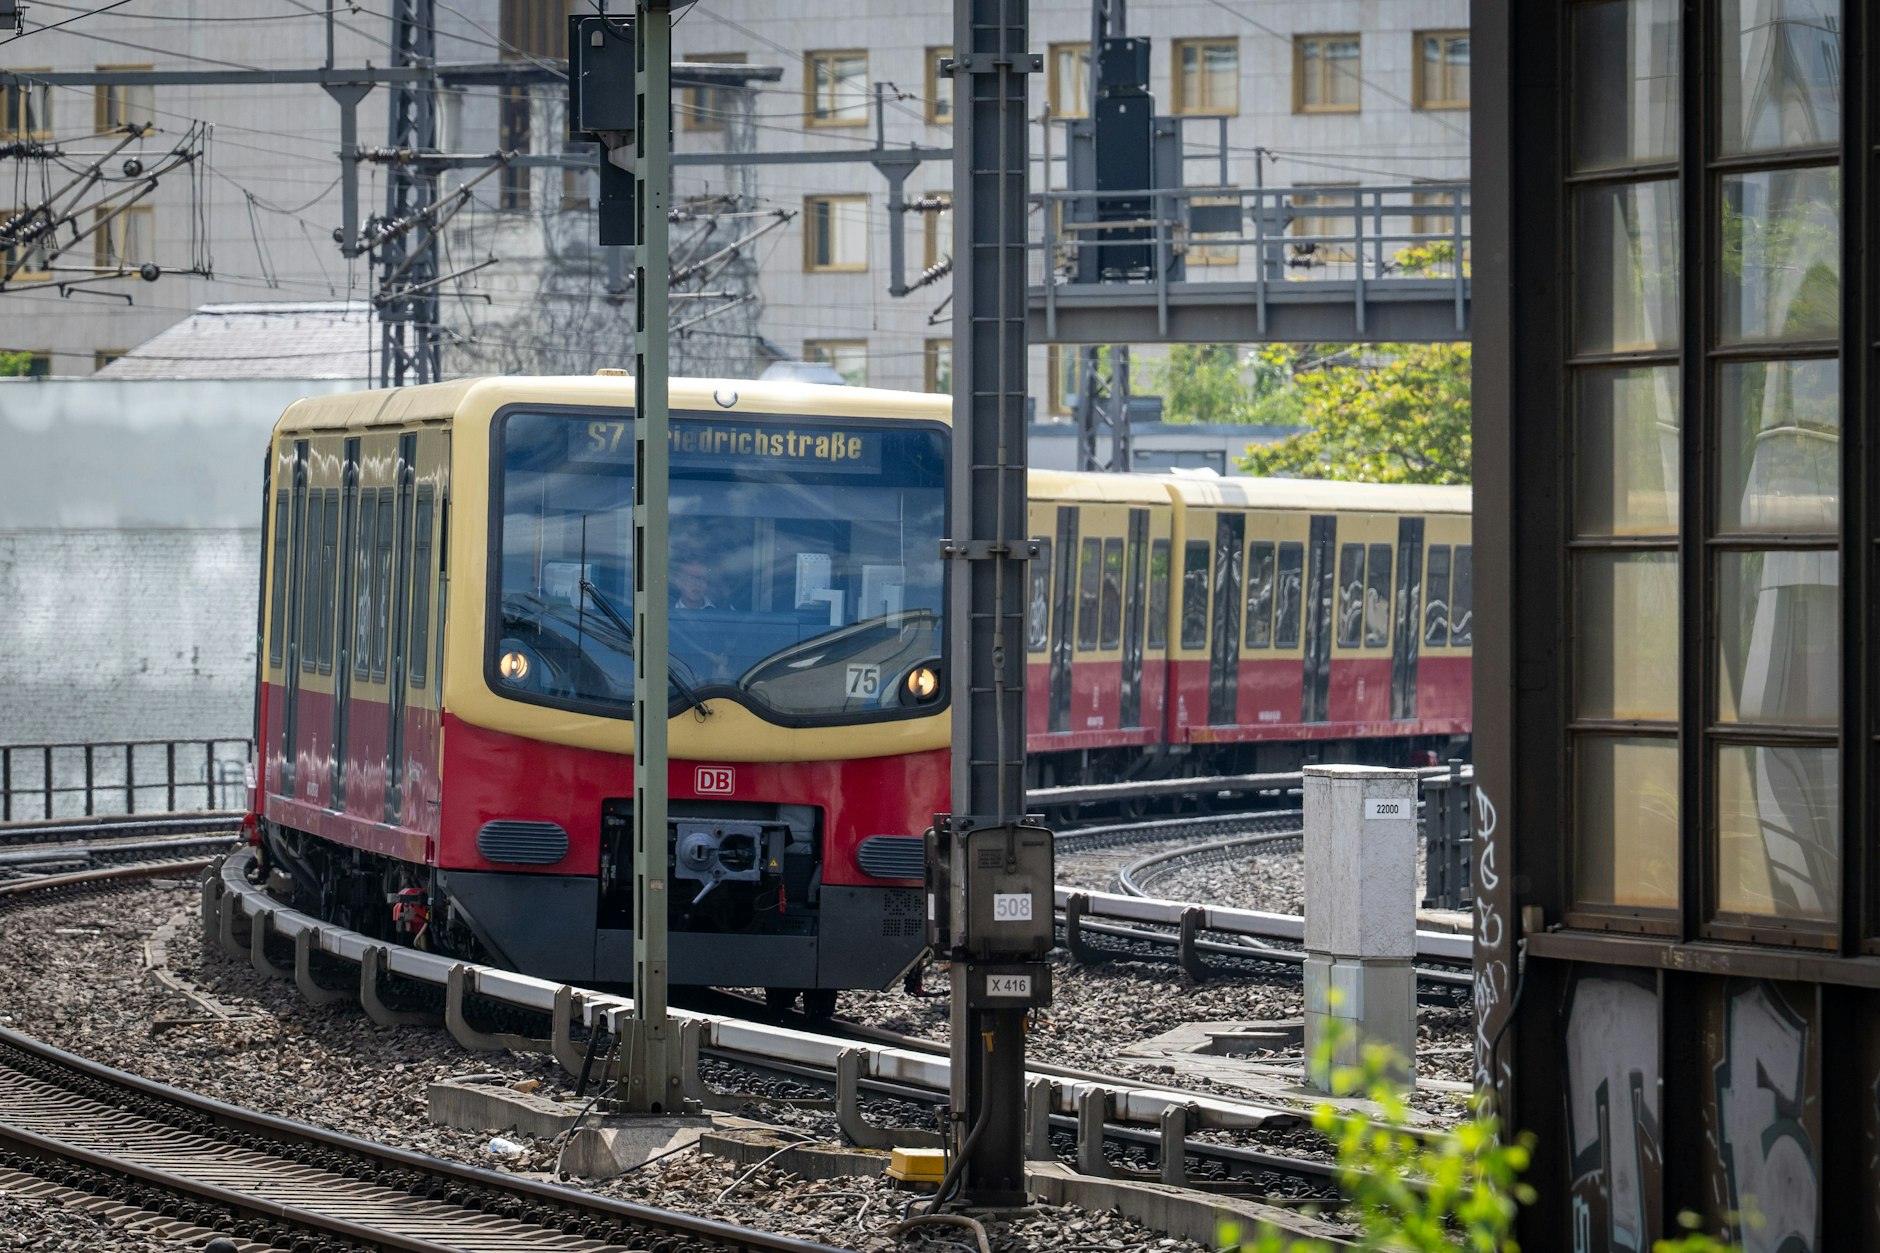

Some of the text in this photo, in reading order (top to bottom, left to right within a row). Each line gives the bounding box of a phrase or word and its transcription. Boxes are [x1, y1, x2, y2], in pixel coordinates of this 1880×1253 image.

[588, 422, 862, 461] S7 iedrichstraße
[849, 667, 877, 694] 75
[700, 771, 729, 789] DB
[1376, 804, 1399, 814] 22000
[997, 898, 1030, 916] 508
[992, 979, 1026, 992] X 416
